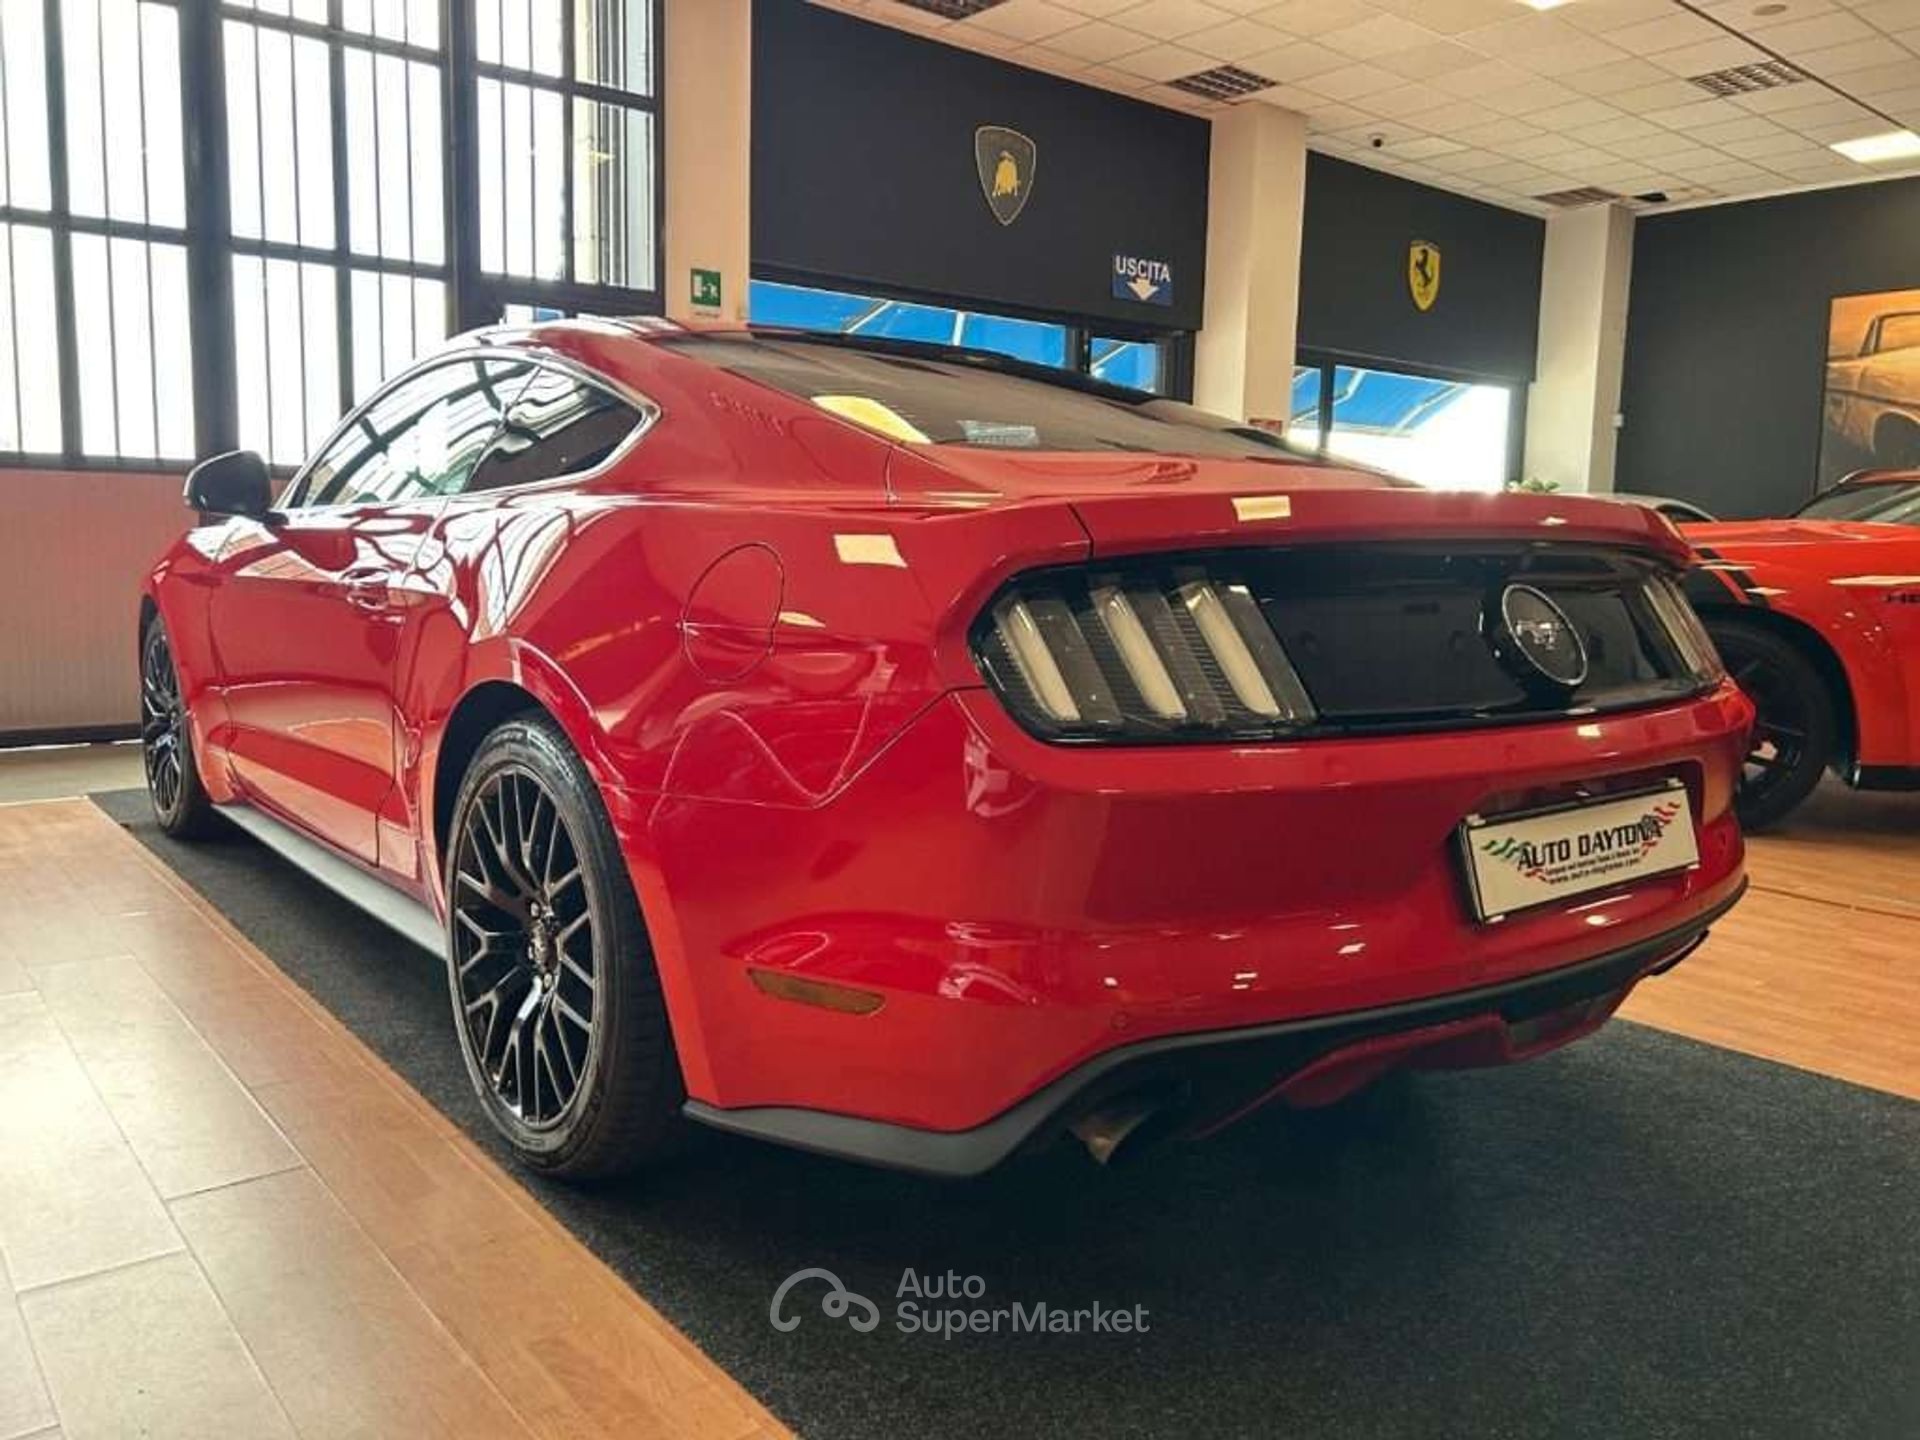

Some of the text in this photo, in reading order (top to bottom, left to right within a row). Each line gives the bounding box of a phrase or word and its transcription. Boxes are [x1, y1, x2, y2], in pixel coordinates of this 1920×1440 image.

[1115, 255, 1171, 282] USCITA
[1517, 838, 1570, 870] AUTO
[1578, 817, 1663, 857] DAYTONA
